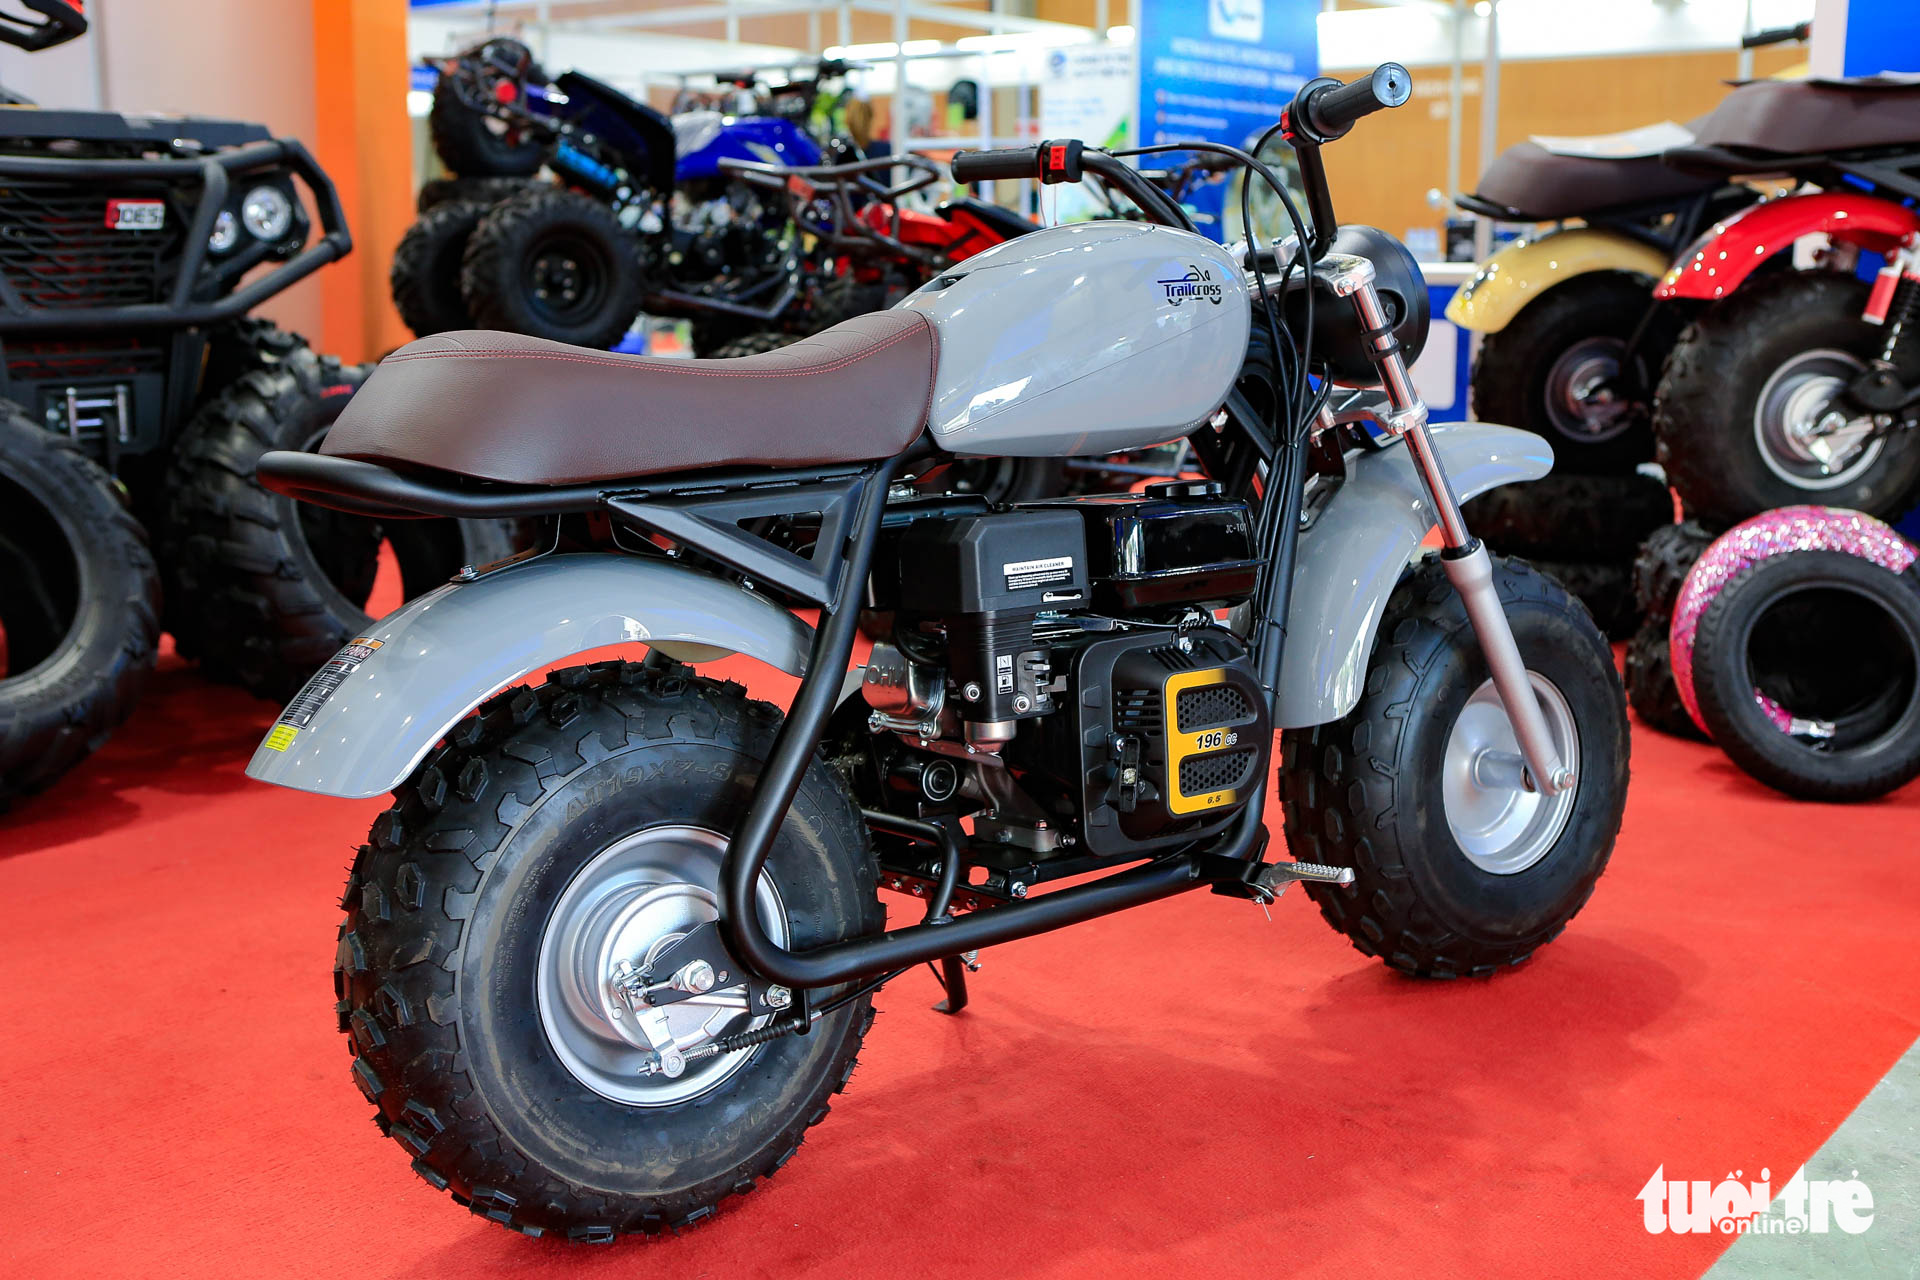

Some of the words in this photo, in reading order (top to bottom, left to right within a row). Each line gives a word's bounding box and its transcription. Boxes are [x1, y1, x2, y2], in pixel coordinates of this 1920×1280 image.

[1164, 283, 1222, 297] Trailcross
[1196, 732, 1222, 750] 196
[1207, 795, 1222, 805] 6.5
